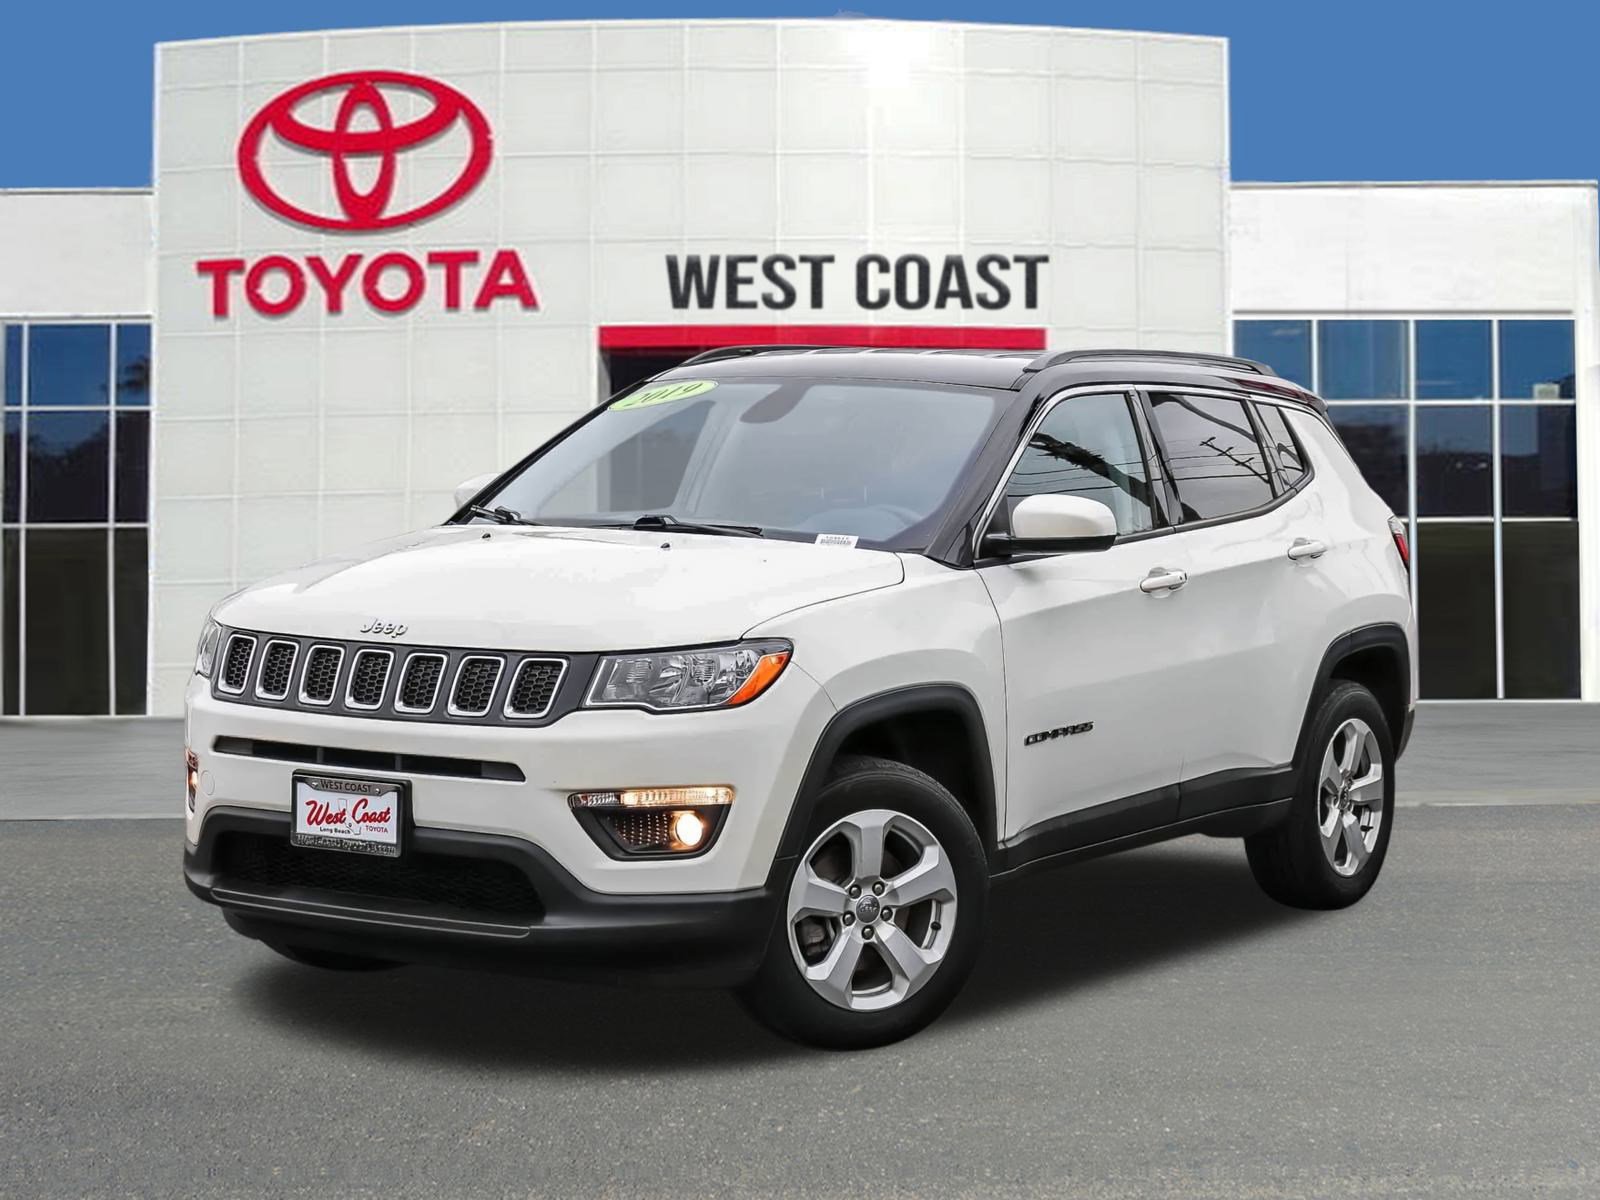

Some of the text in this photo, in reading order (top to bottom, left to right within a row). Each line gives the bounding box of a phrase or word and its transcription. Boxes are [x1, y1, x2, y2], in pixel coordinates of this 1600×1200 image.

[197, 249, 538, 317] TOYOTA
[666, 253, 1050, 310] WEST COAST
[621, 382, 704, 407] 2019
[360, 618, 408, 638] Jeep
[1024, 721, 1094, 746] COMPASS
[320, 780, 371, 793] WEST COAST
[305, 798, 391, 826] West Coast
[319, 826, 351, 835] Long Beach
[365, 825, 388, 834] TOYOTA
